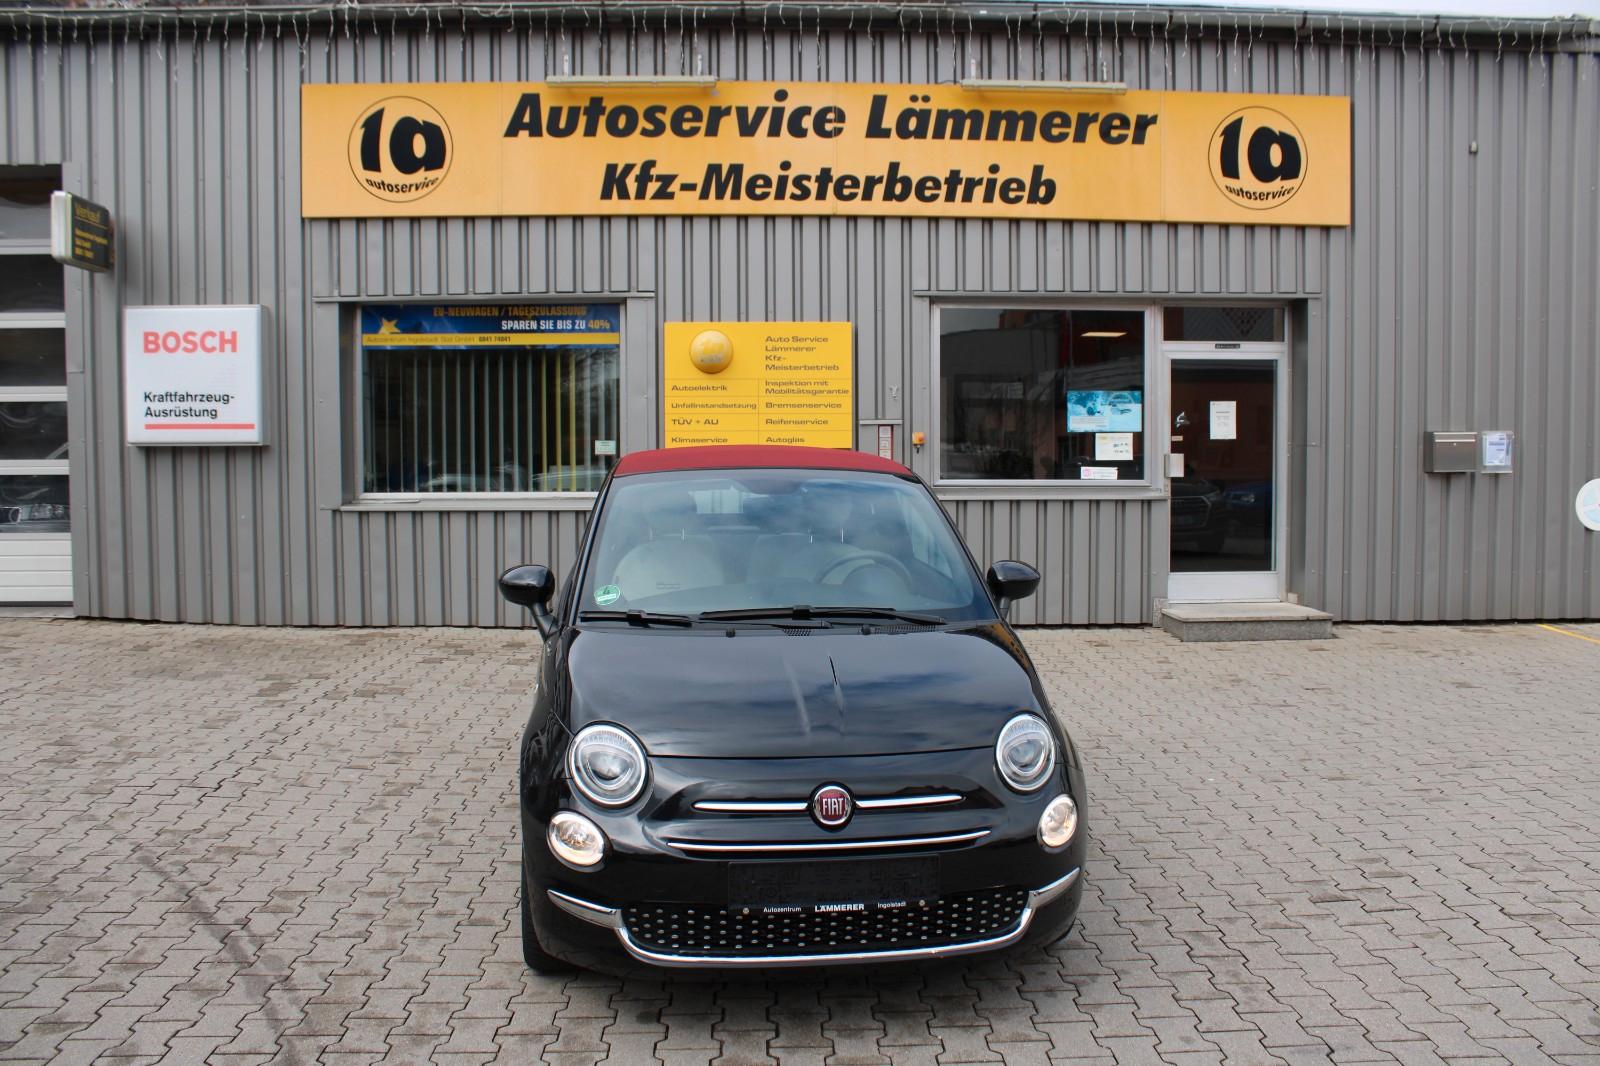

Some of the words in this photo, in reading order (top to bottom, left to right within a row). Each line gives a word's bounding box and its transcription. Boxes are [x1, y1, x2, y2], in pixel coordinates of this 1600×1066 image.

[503, 89, 846, 138] Autoservice
[865, 95, 1158, 145] Lämmerer
[360, 106, 446, 175] 1a
[1219, 116, 1302, 183] 1a
[365, 177, 439, 193] autoservice
[600, 160, 1056, 205] Kfz-Meisterbetrieb
[1225, 185, 1294, 201] autoservice
[502, 320, 537, 330] SPAREN
[540, 319, 554, 330] SIE
[557, 319, 572, 330] BIS
[574, 319, 586, 330] ZU
[588, 319, 610, 329] 40%
[143, 331, 237, 353] BOSCH
[765, 344, 816, 352] Lämmerer
[765, 363, 839, 371] Meisterbetrieb
[765, 380, 812, 388] Inspektion
[765, 387, 849, 396] Mobilitätsgarantie
[144, 391, 235, 406] Kraftfahrzeug-
[144, 406, 218, 419] Ausrüstung
[671, 402, 757, 410] Unfallinstandsetzung
[671, 416, 692, 425] TÜV
[765, 436, 805, 444] Autoglas
[822, 797, 844, 815] FIAT
[815, 903, 865, 913] LÄMMERER
[878, 901, 907, 909] Ingolstadt
